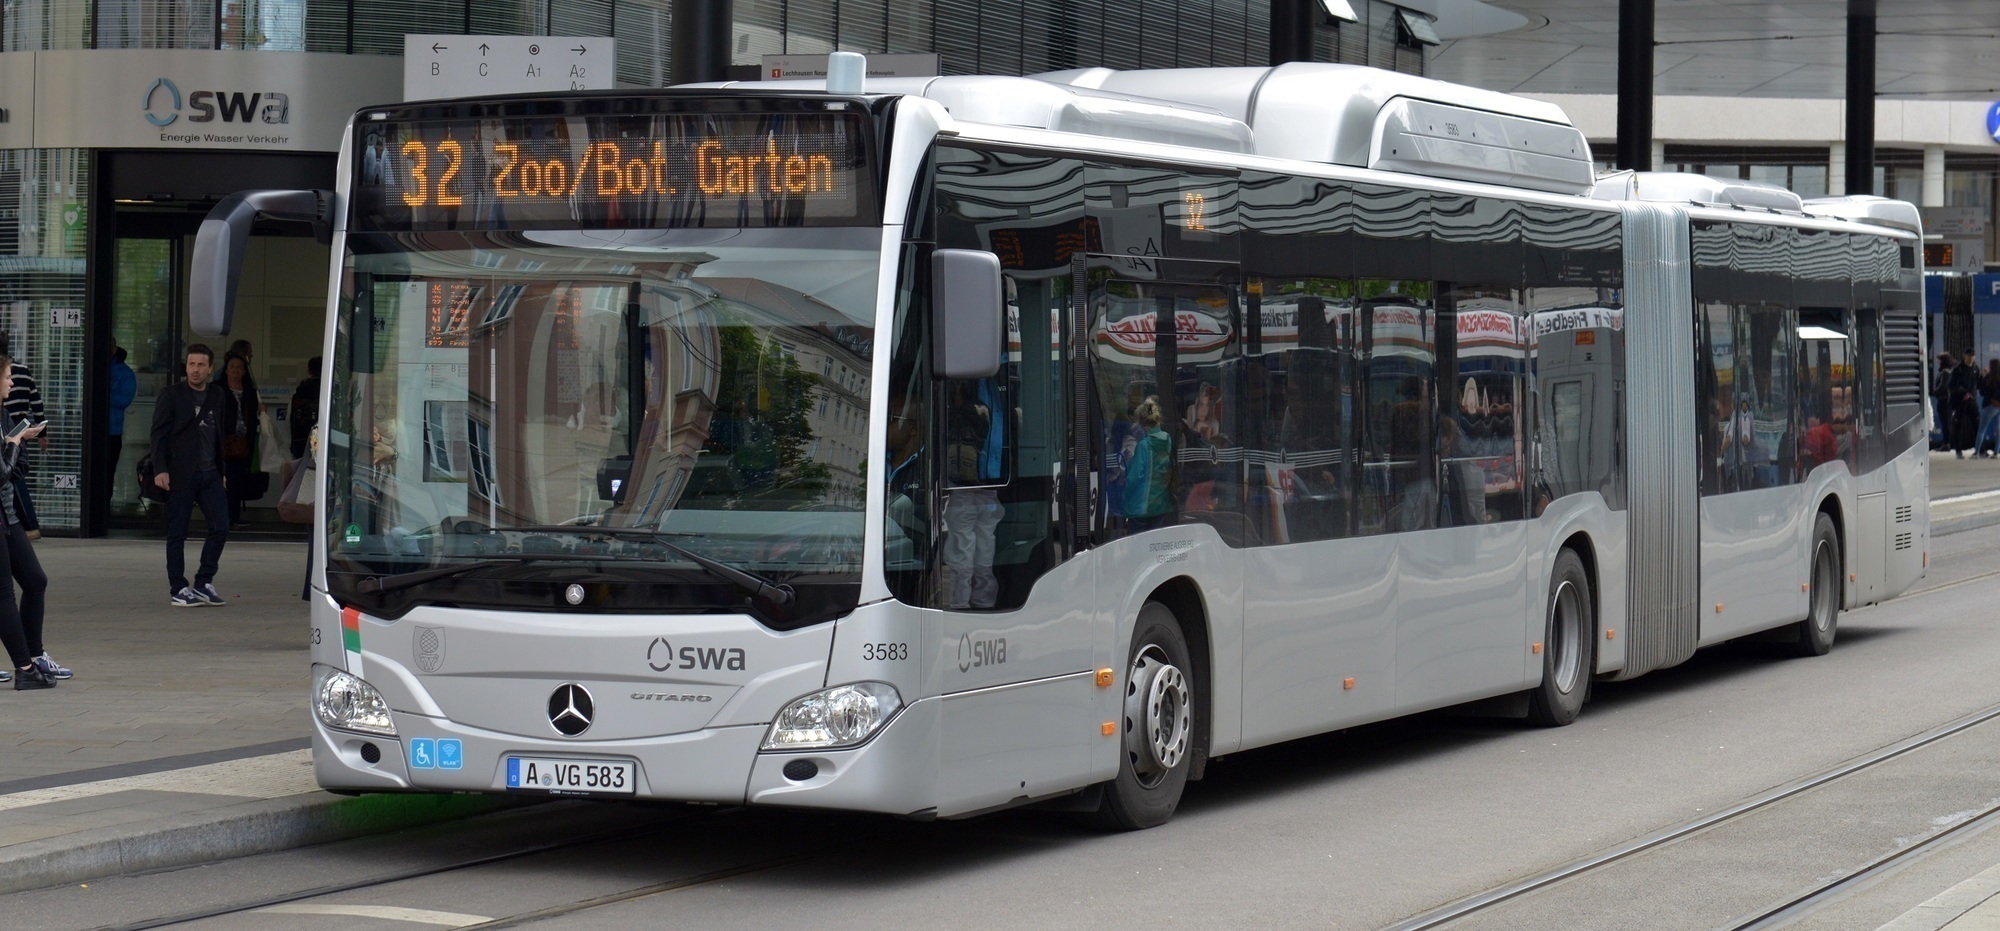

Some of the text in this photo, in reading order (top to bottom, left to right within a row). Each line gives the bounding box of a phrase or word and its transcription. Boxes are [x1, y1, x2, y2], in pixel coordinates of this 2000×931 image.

[431, 62, 586, 78] B C A1 A2
[188, 90, 290, 125] swa
[160, 133, 289, 144] Energie Wasser Verkehr
[1445, 122, 1460, 137] 3583
[402, 138, 832, 206] 32 Zoo/Bot. Garten
[1186, 192, 1205, 230] 32
[350, 525, 356, 537] 4
[678, 646, 746, 671] swa
[863, 642, 908, 661] 3583
[973, 637, 1007, 668] swa
[526, 762, 625, 788] A VG 583
